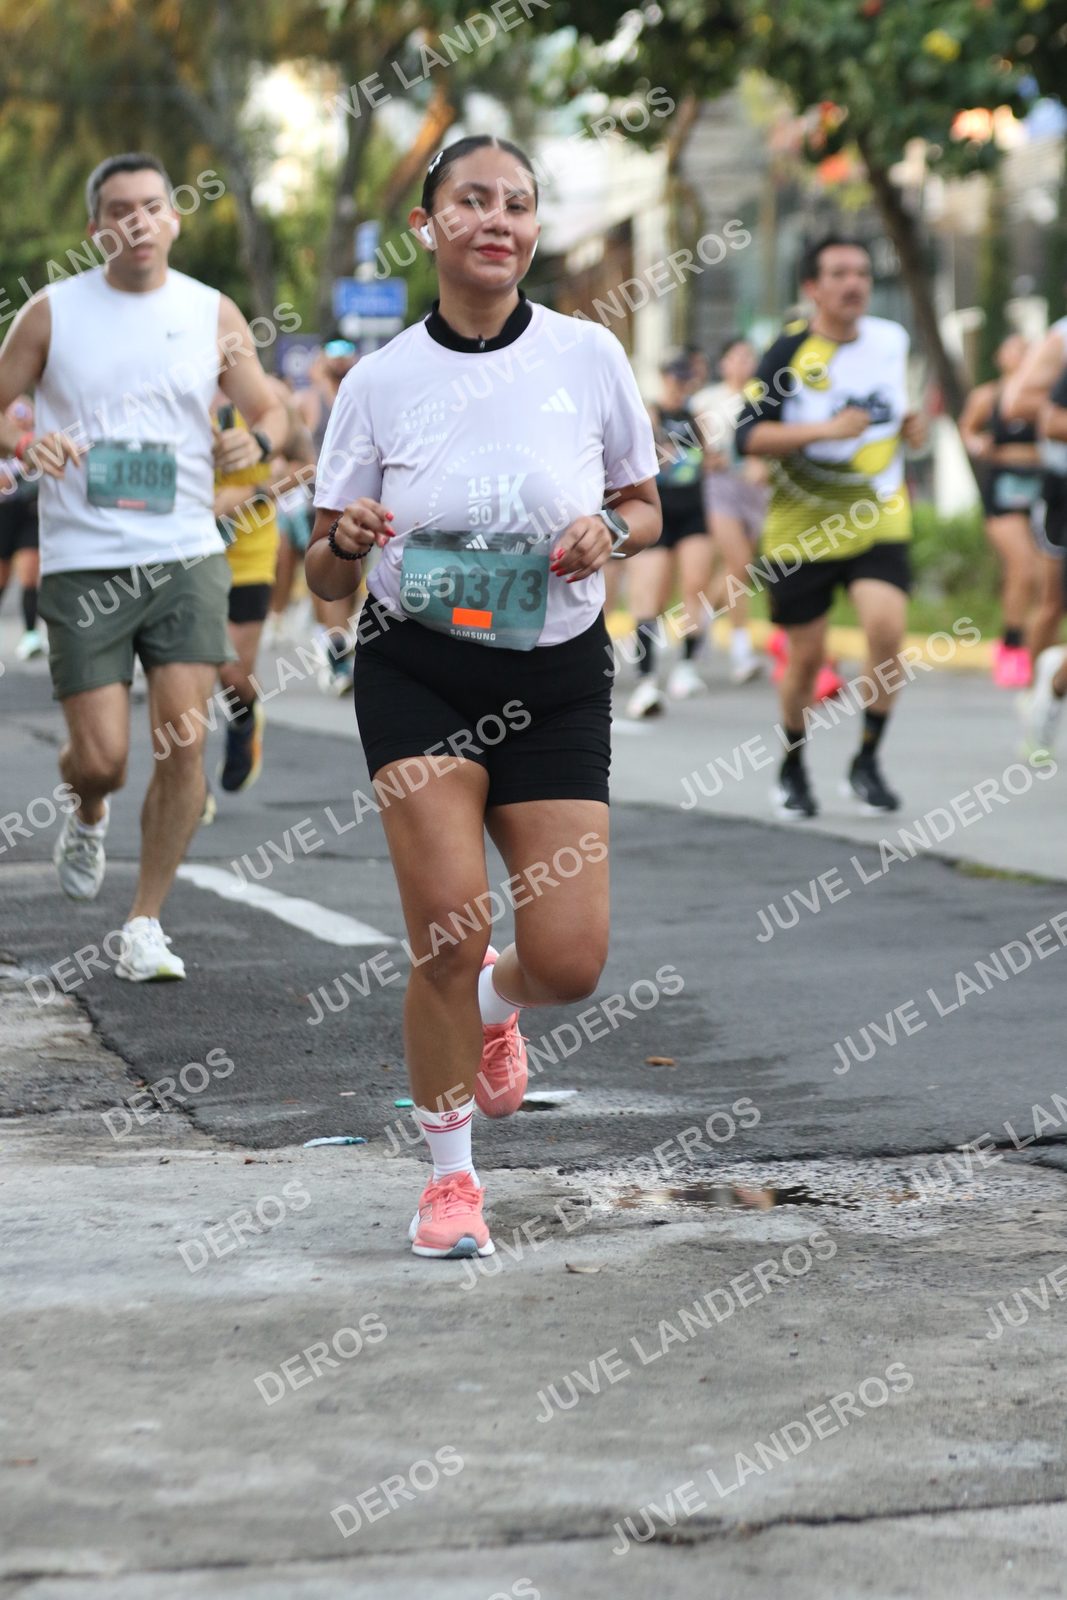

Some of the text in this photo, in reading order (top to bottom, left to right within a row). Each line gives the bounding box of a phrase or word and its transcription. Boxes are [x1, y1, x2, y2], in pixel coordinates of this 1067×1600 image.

[113, 458, 173, 490] 1889
[467, 472, 530, 524] 15 K
[467, 505, 492, 526] 30
[404, 572, 432, 580] ADIDAS
[441, 565, 543, 612] 0373
[450, 628, 497, 641] SAMSUNG
